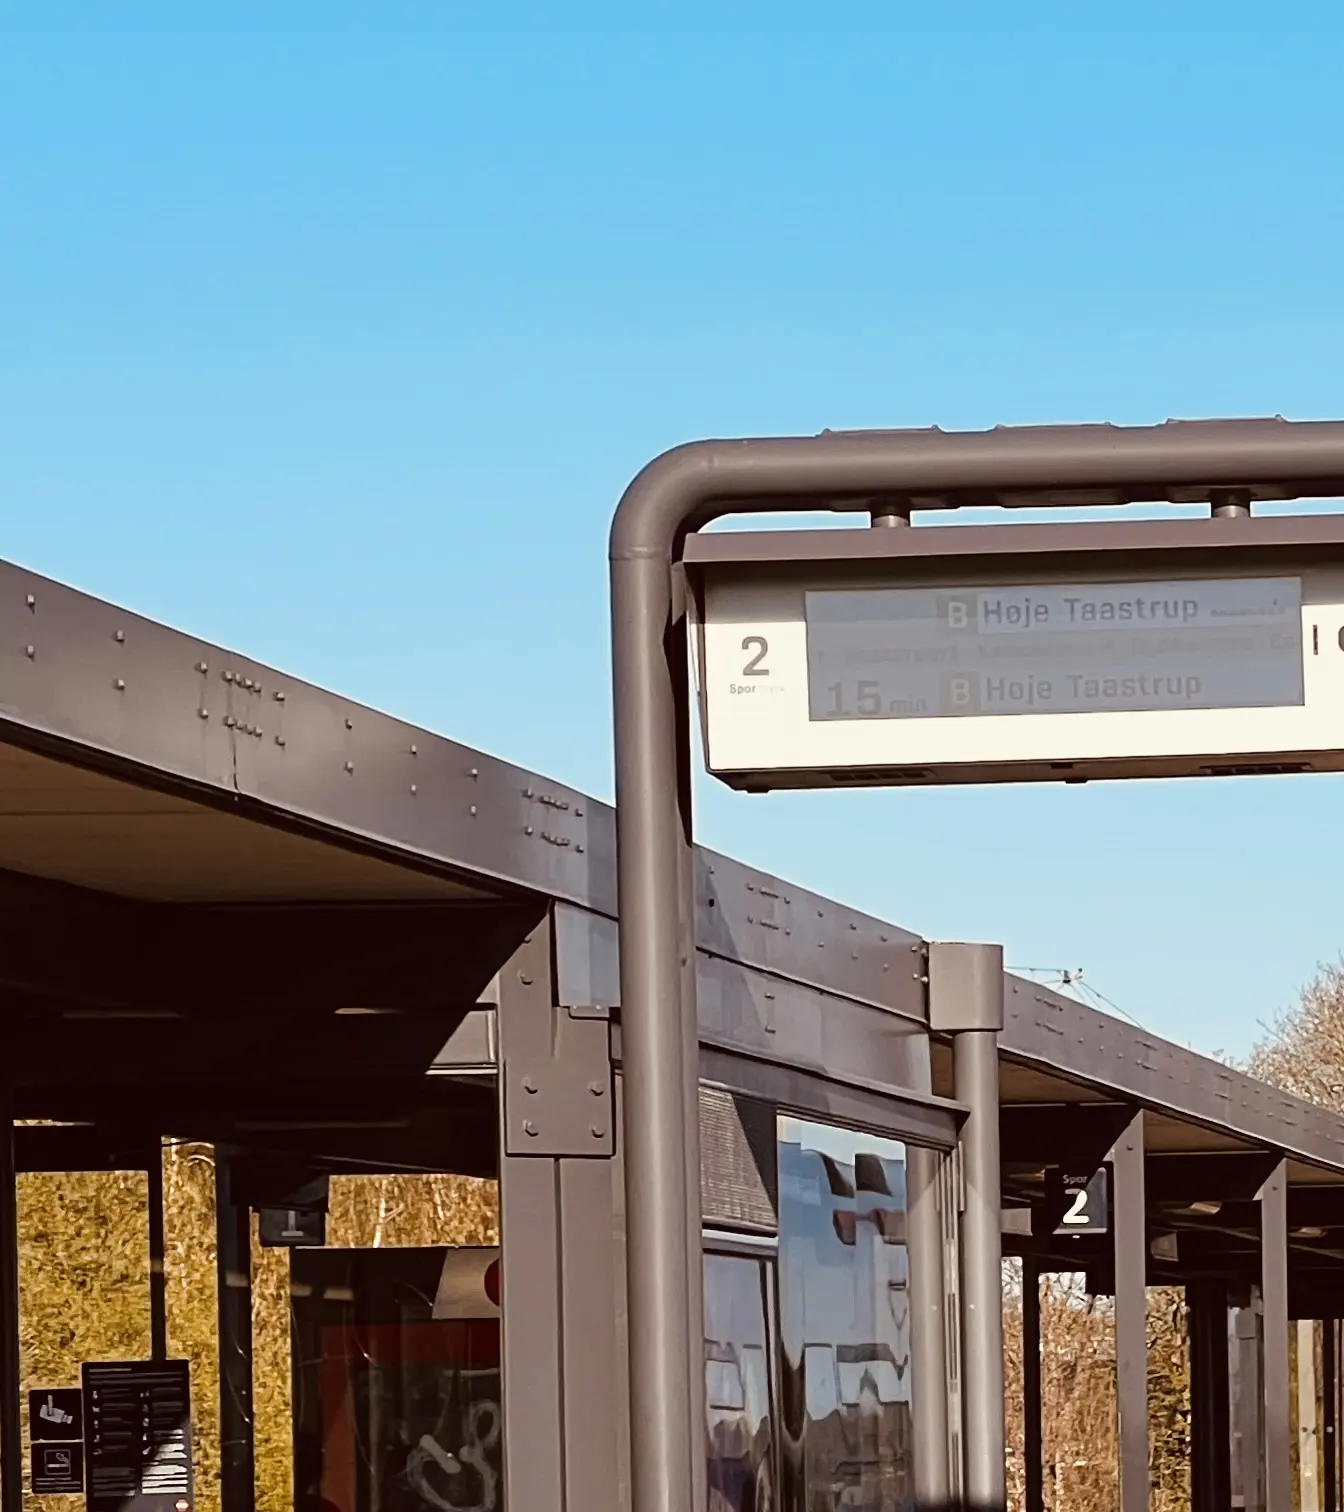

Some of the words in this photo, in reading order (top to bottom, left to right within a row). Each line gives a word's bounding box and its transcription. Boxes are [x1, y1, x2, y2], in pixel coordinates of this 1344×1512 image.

[948, 603, 967, 629] B
[983, 598, 1050, 628] Høje
[1064, 598, 1199, 625] Taastrup
[741, 636, 770, 676] 2
[827, 680, 882, 716] 15
[986, 676, 1053, 705] Høje
[1067, 674, 1202, 700] Taastrup
[1062, 1188, 1090, 1224] 2
